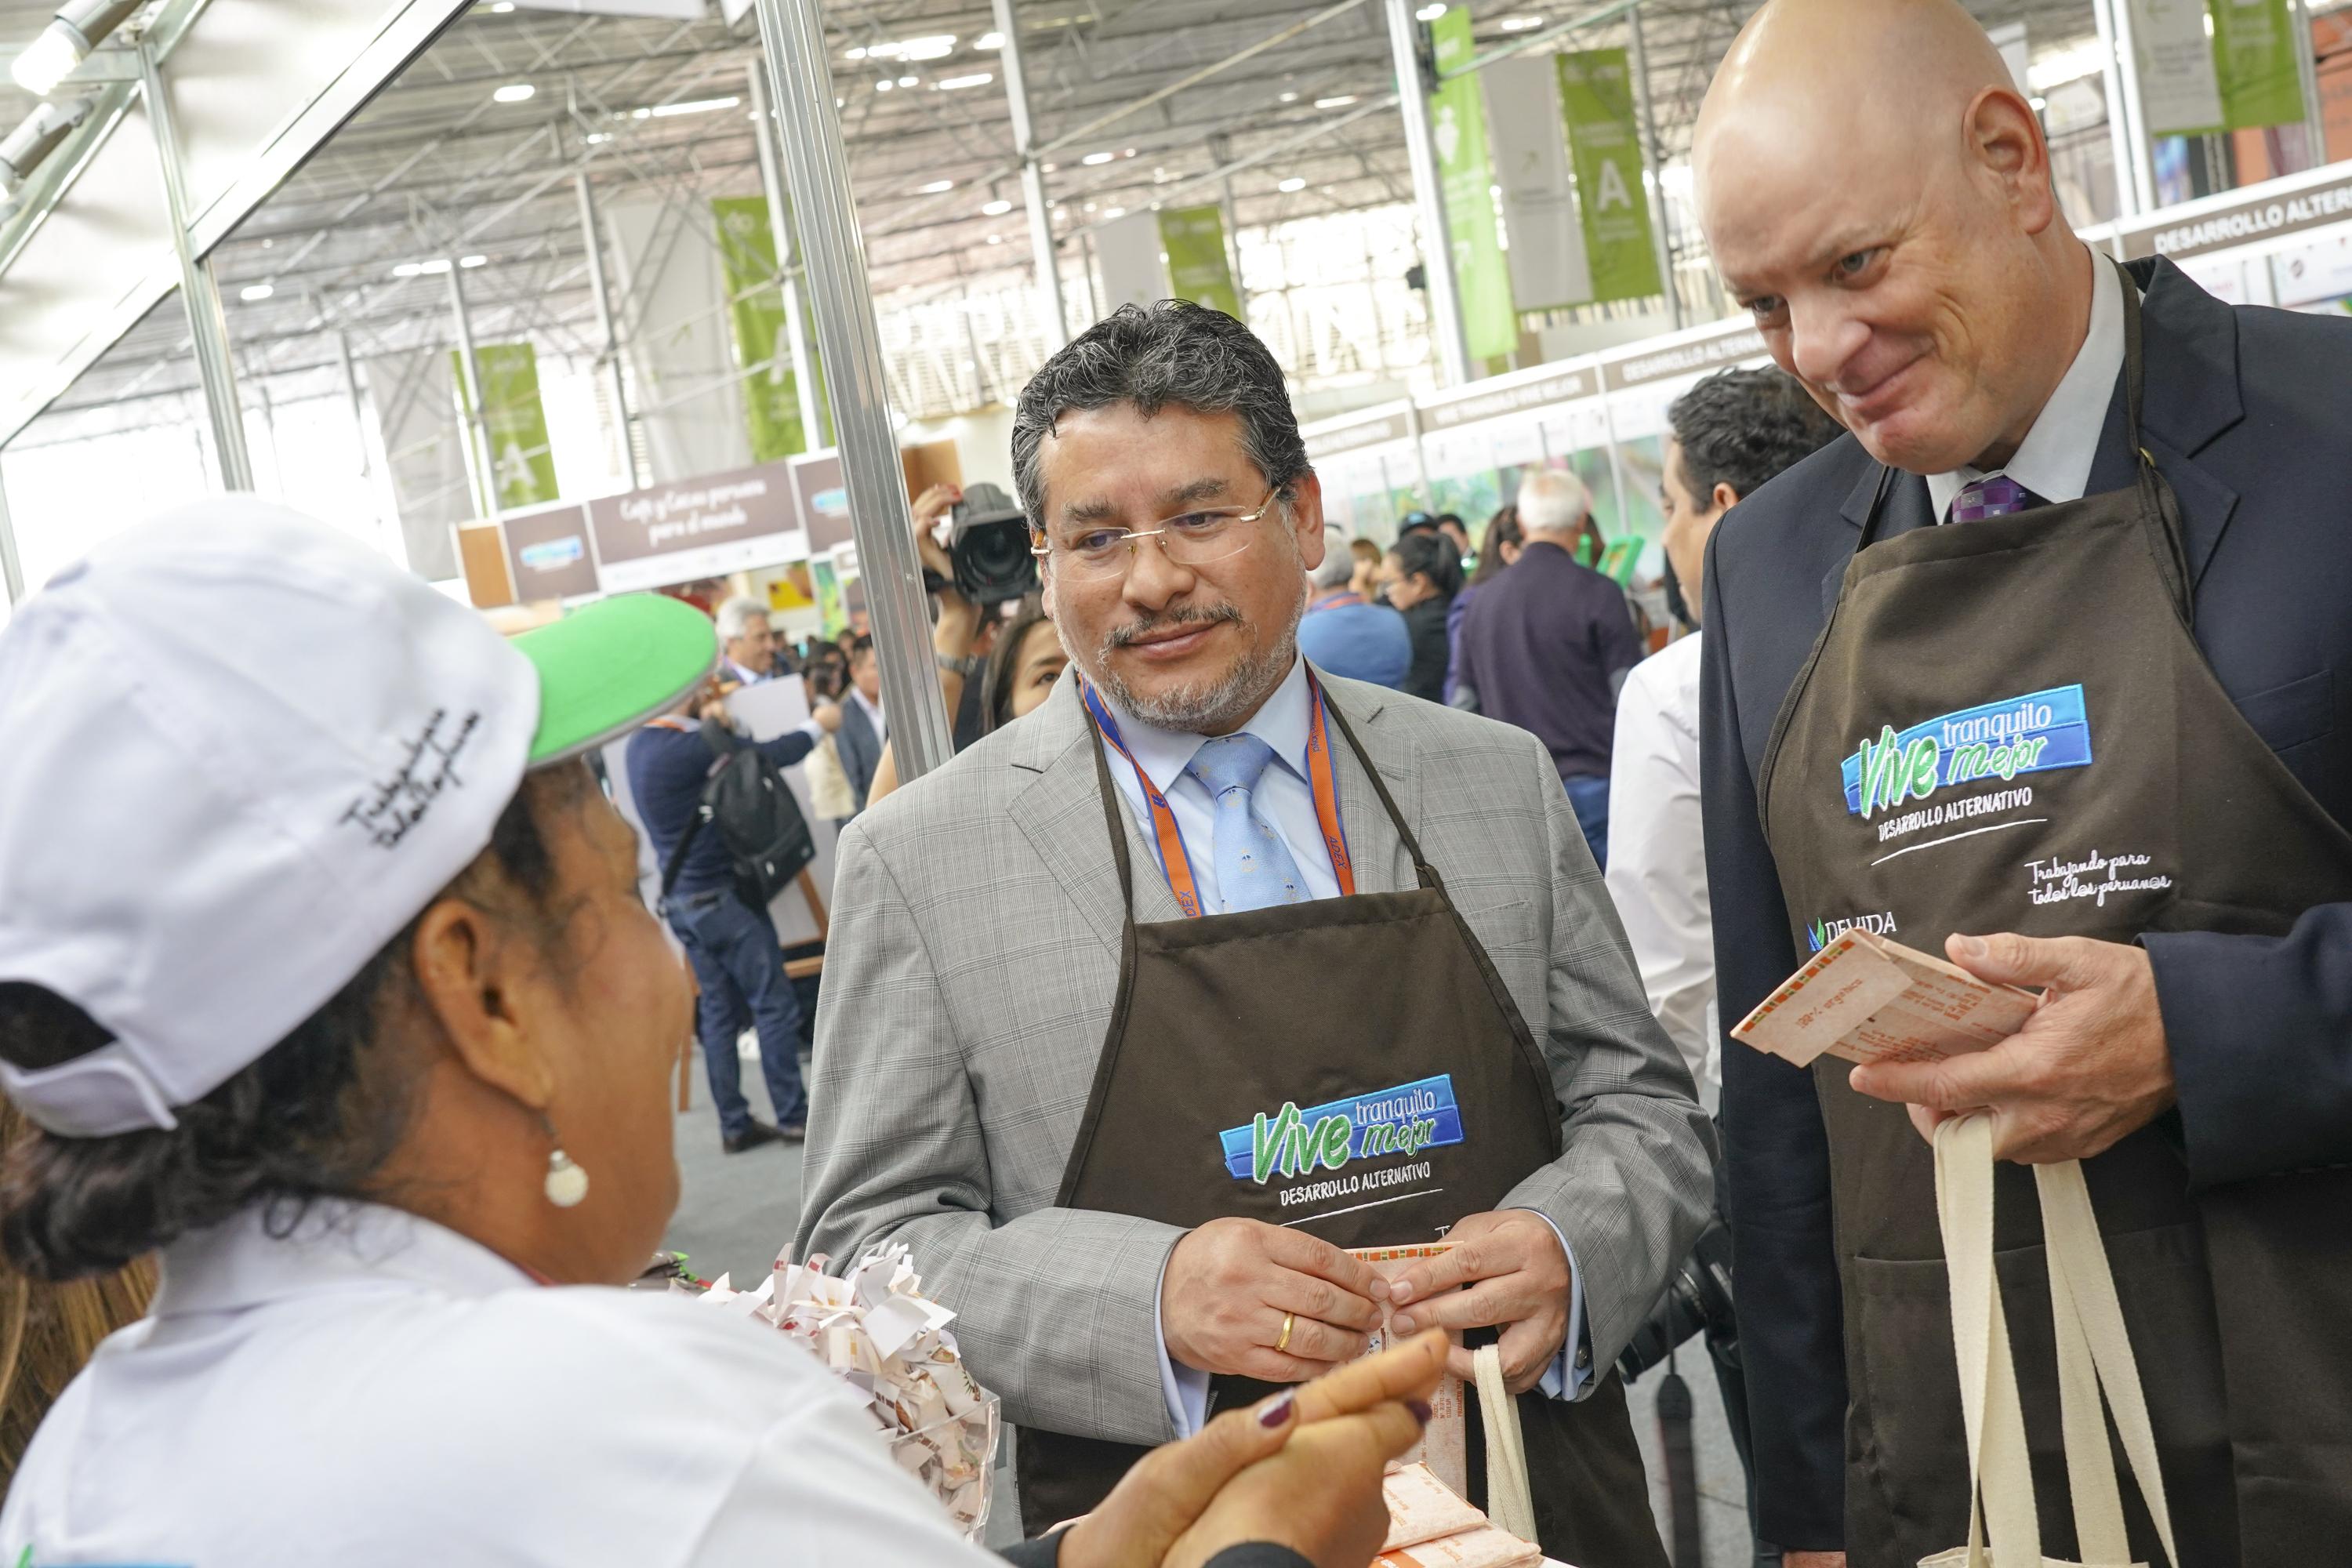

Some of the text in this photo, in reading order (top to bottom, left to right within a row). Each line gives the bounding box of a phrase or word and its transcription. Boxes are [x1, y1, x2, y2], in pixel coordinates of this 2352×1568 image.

[1597, 158, 1633, 212] A
[2154, 204, 2285, 256] DESARROLLO
[1860, 703, 2053, 819] Vive tranquilo
[1947, 733, 2048, 781] mejor
[1878, 787, 2033, 841] DESARROLLO ALTERNATIVO
[2024, 850, 2151, 887] Trabajando para
[1179, 891, 1196, 916] DEX
[1252, 1088, 1436, 1185] Vive tranquilo
[1360, 1115, 1436, 1159] mejor
[1279, 1161, 1431, 1207] DESARROLLO ALTERNATIVO
